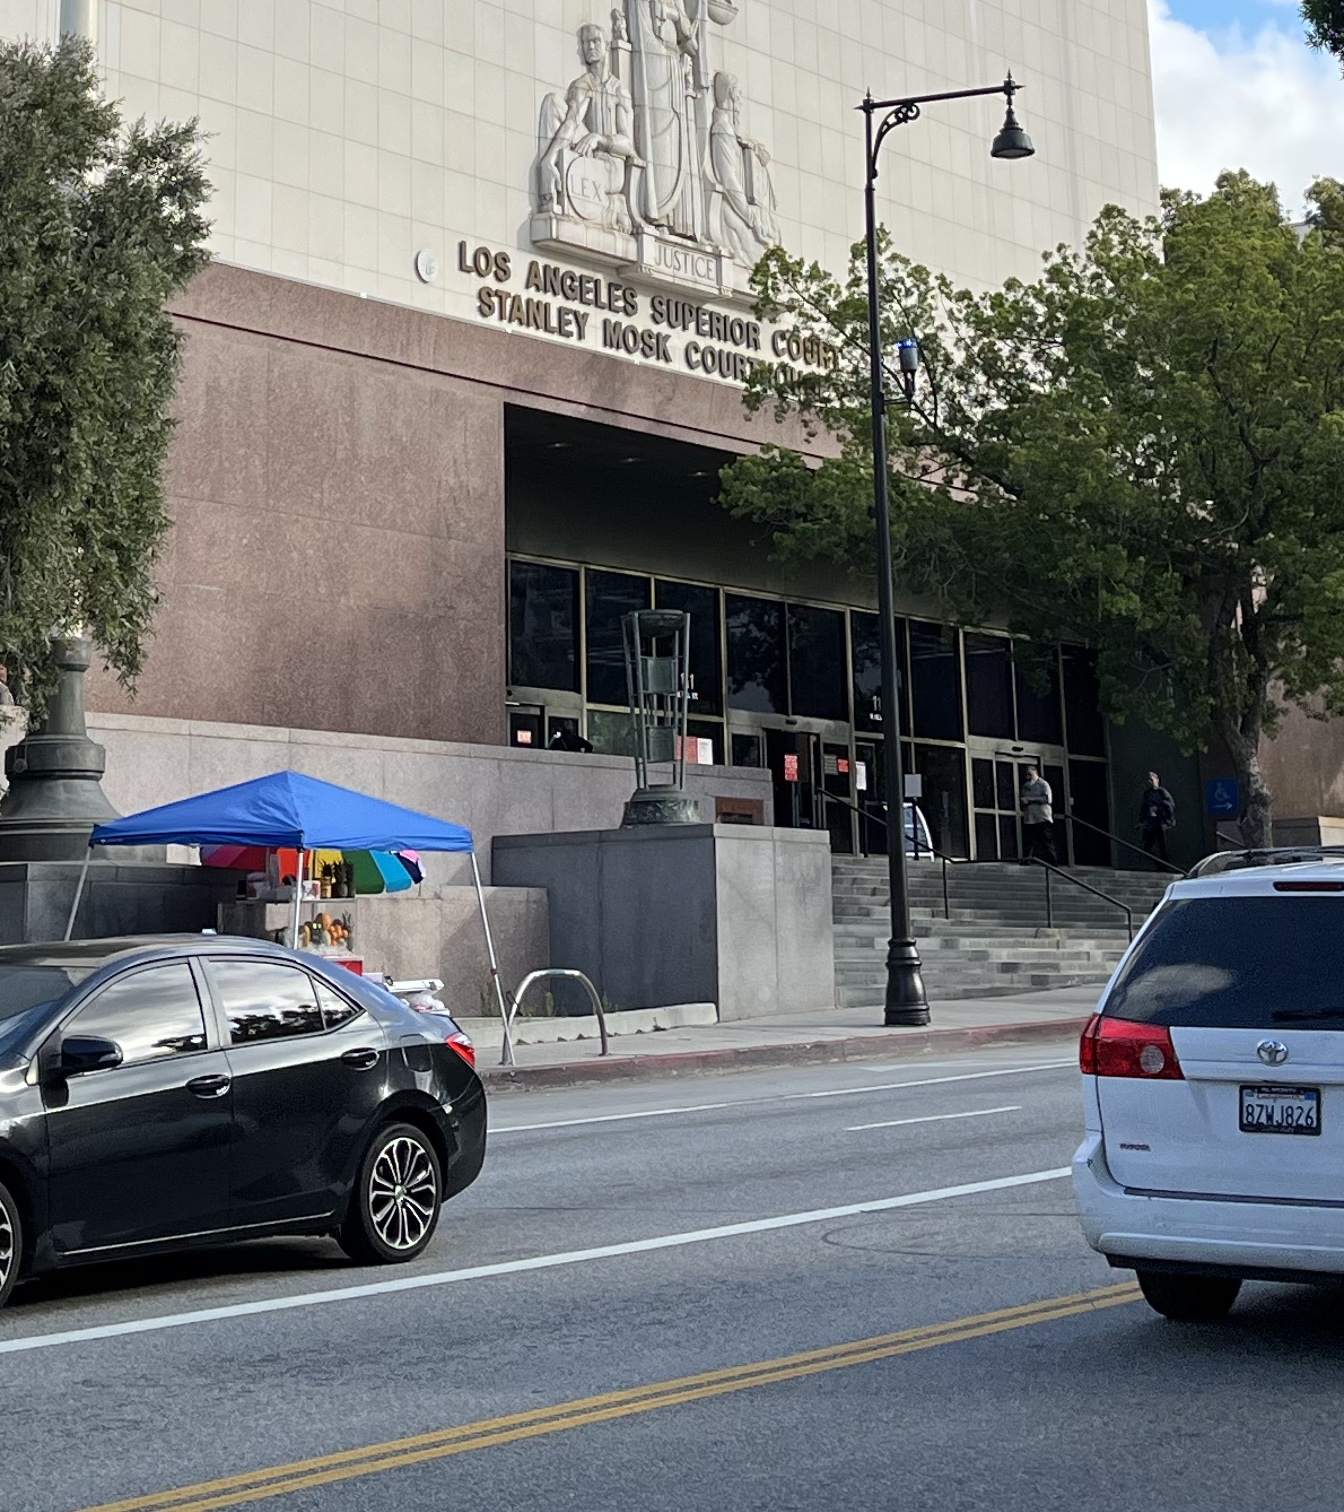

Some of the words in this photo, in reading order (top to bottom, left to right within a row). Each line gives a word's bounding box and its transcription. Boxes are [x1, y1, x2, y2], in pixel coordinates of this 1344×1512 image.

[570, 174, 603, 202] LEX
[654, 244, 716, 281] JUSTICE
[458, 240, 511, 282] LOS
[525, 260, 638, 316] ANGELES
[651, 295, 761, 350] SUPERIOR
[478, 286, 589, 340] STANLEY
[603, 318, 672, 363] MOSK
[1245, 1103, 1315, 1127] 8ZWJ826
